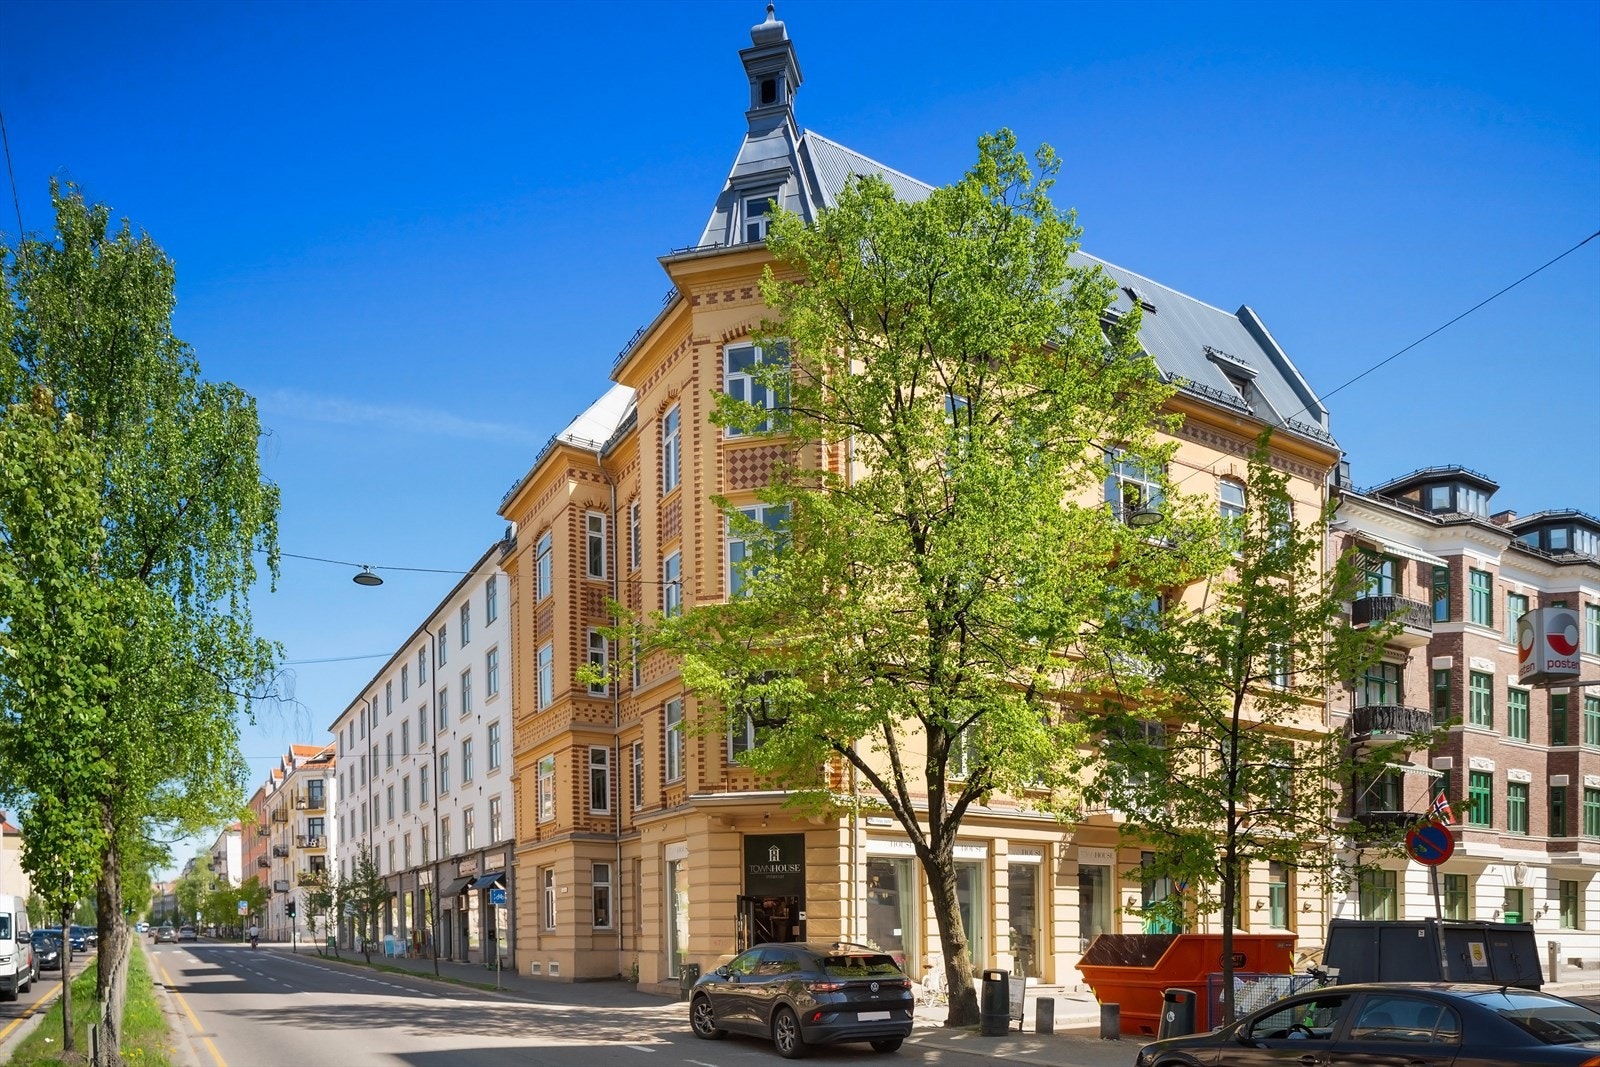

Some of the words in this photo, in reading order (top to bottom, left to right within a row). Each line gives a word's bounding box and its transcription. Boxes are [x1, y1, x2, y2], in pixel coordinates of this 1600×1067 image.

[1519, 662, 1535, 677] sten
[1547, 658, 1580, 670] posten
[749, 864, 801, 873] TOWNHOUSE
